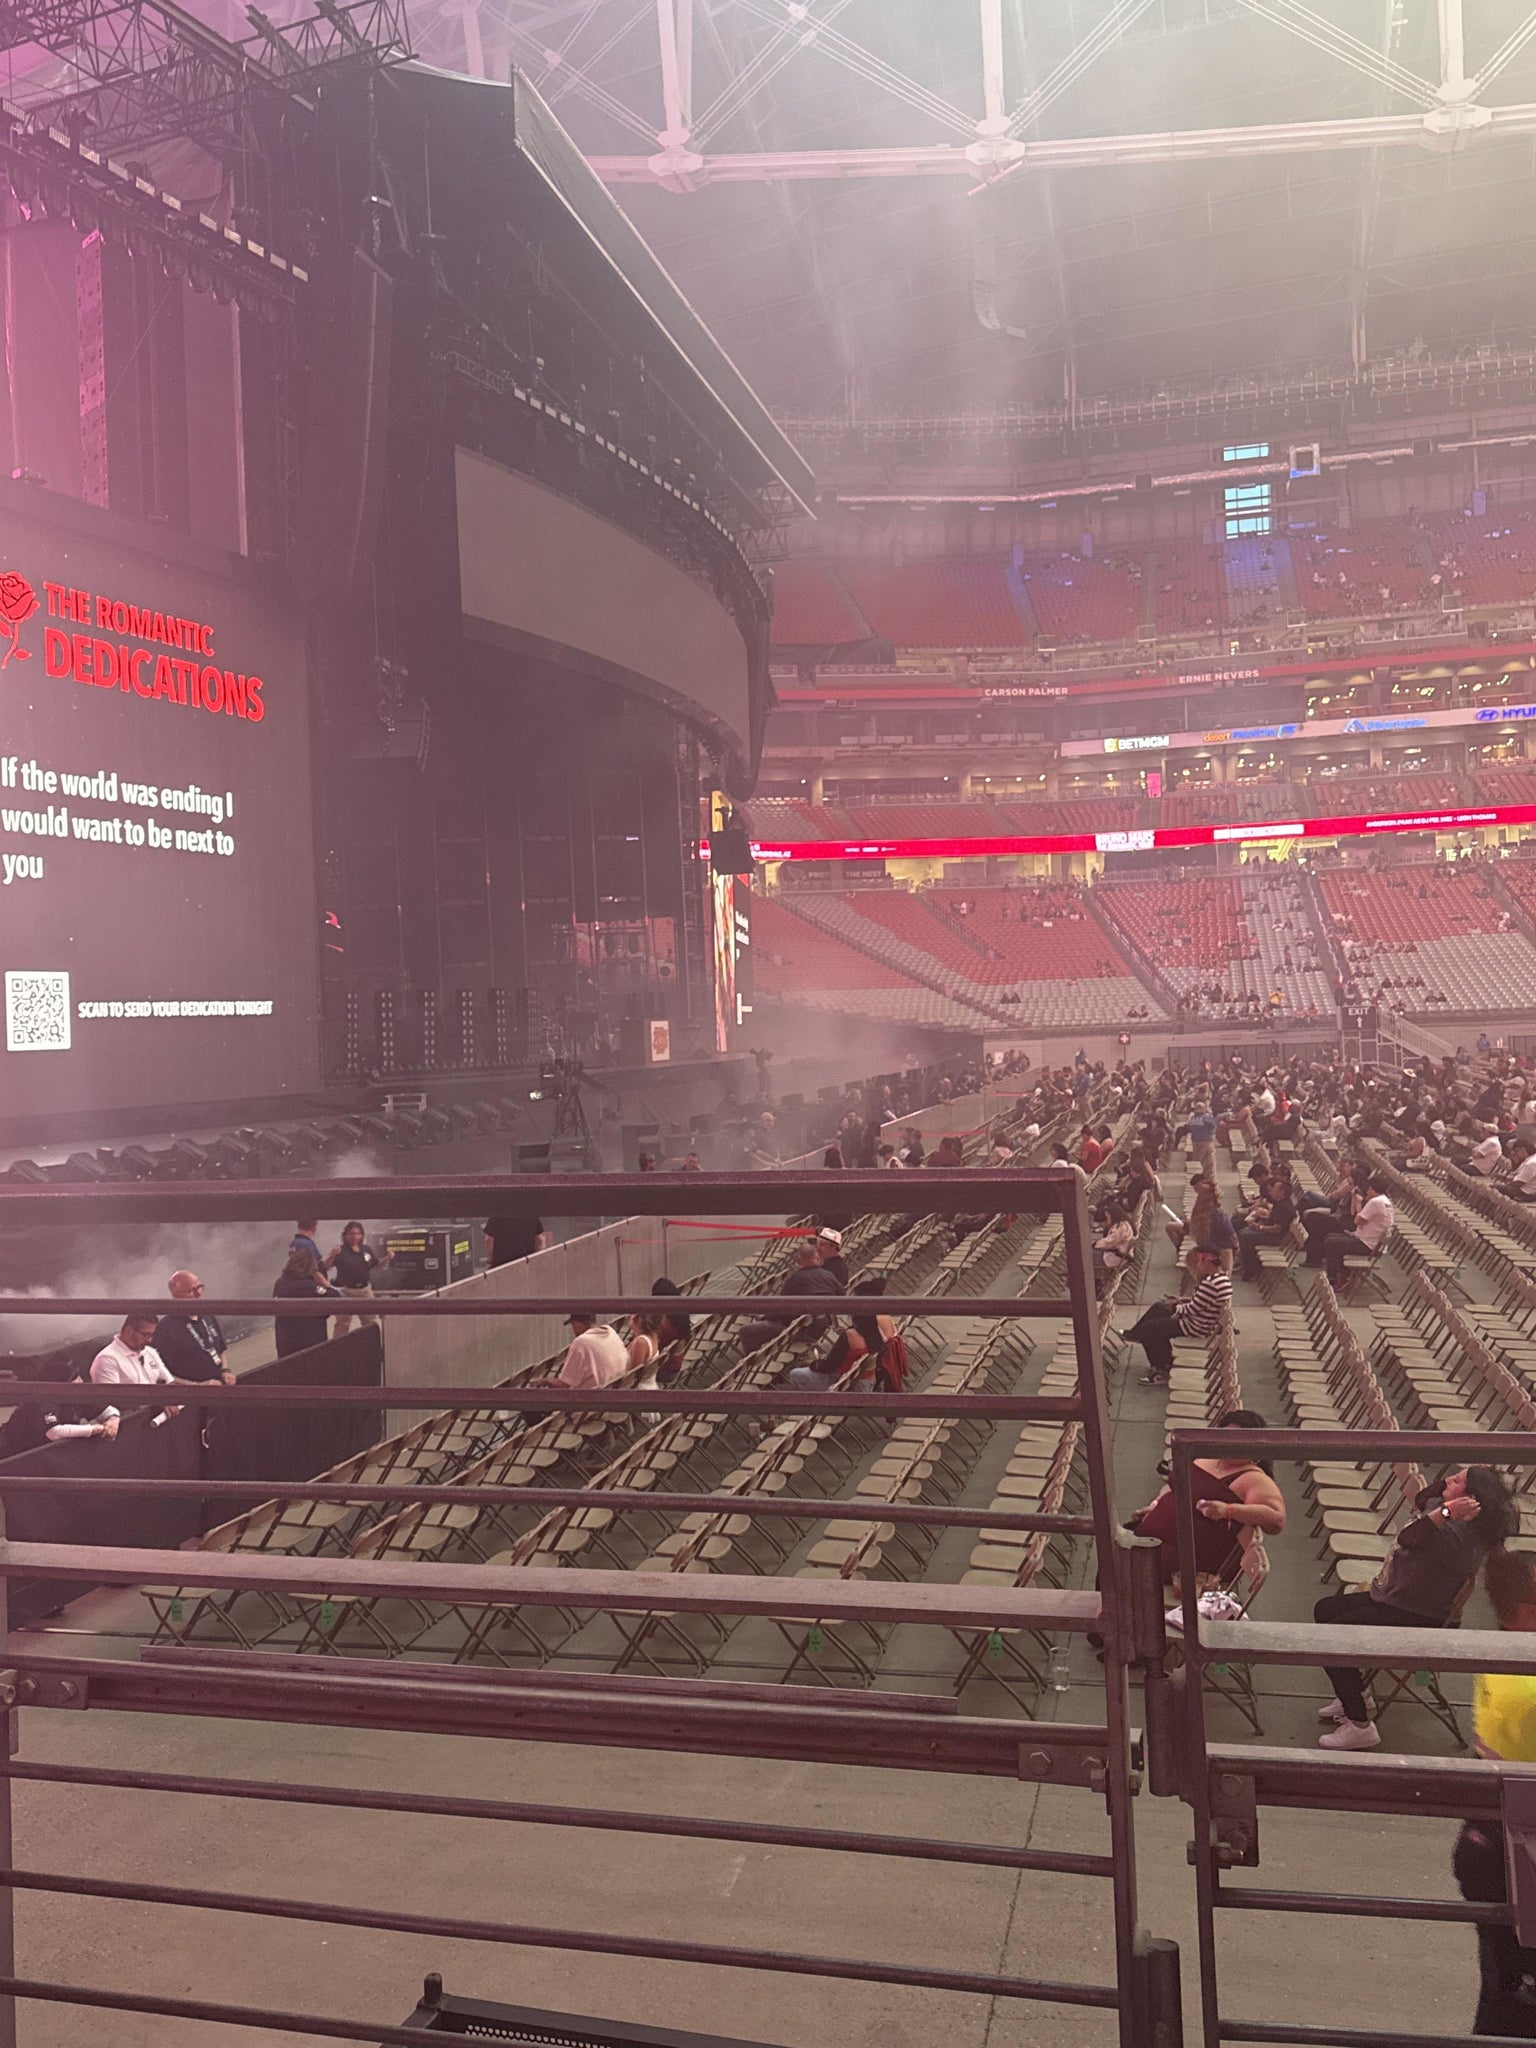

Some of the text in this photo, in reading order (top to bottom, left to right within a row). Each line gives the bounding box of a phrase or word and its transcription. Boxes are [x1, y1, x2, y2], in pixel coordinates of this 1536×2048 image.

[43, 581, 215, 657] THE ROMANTIC
[44, 626, 264, 722] DEDICATIONS
[1179, 673, 1212, 684] ERNIE
[1215, 669, 1260, 681] NEVERS
[985, 688, 1026, 697] CARSON
[1028, 687, 1069, 696] PALMER
[1118, 735, 1169, 750] BETMGM
[1, 756, 234, 823] If the world was ending I
[1, 806, 235, 856] would want to be next to
[2, 853, 44, 885] you
[78, 1000, 273, 1018] SCAN TO SEND YOUR DEDICATION TONIGHT
[1348, 1007, 1368, 1016] EXIT
